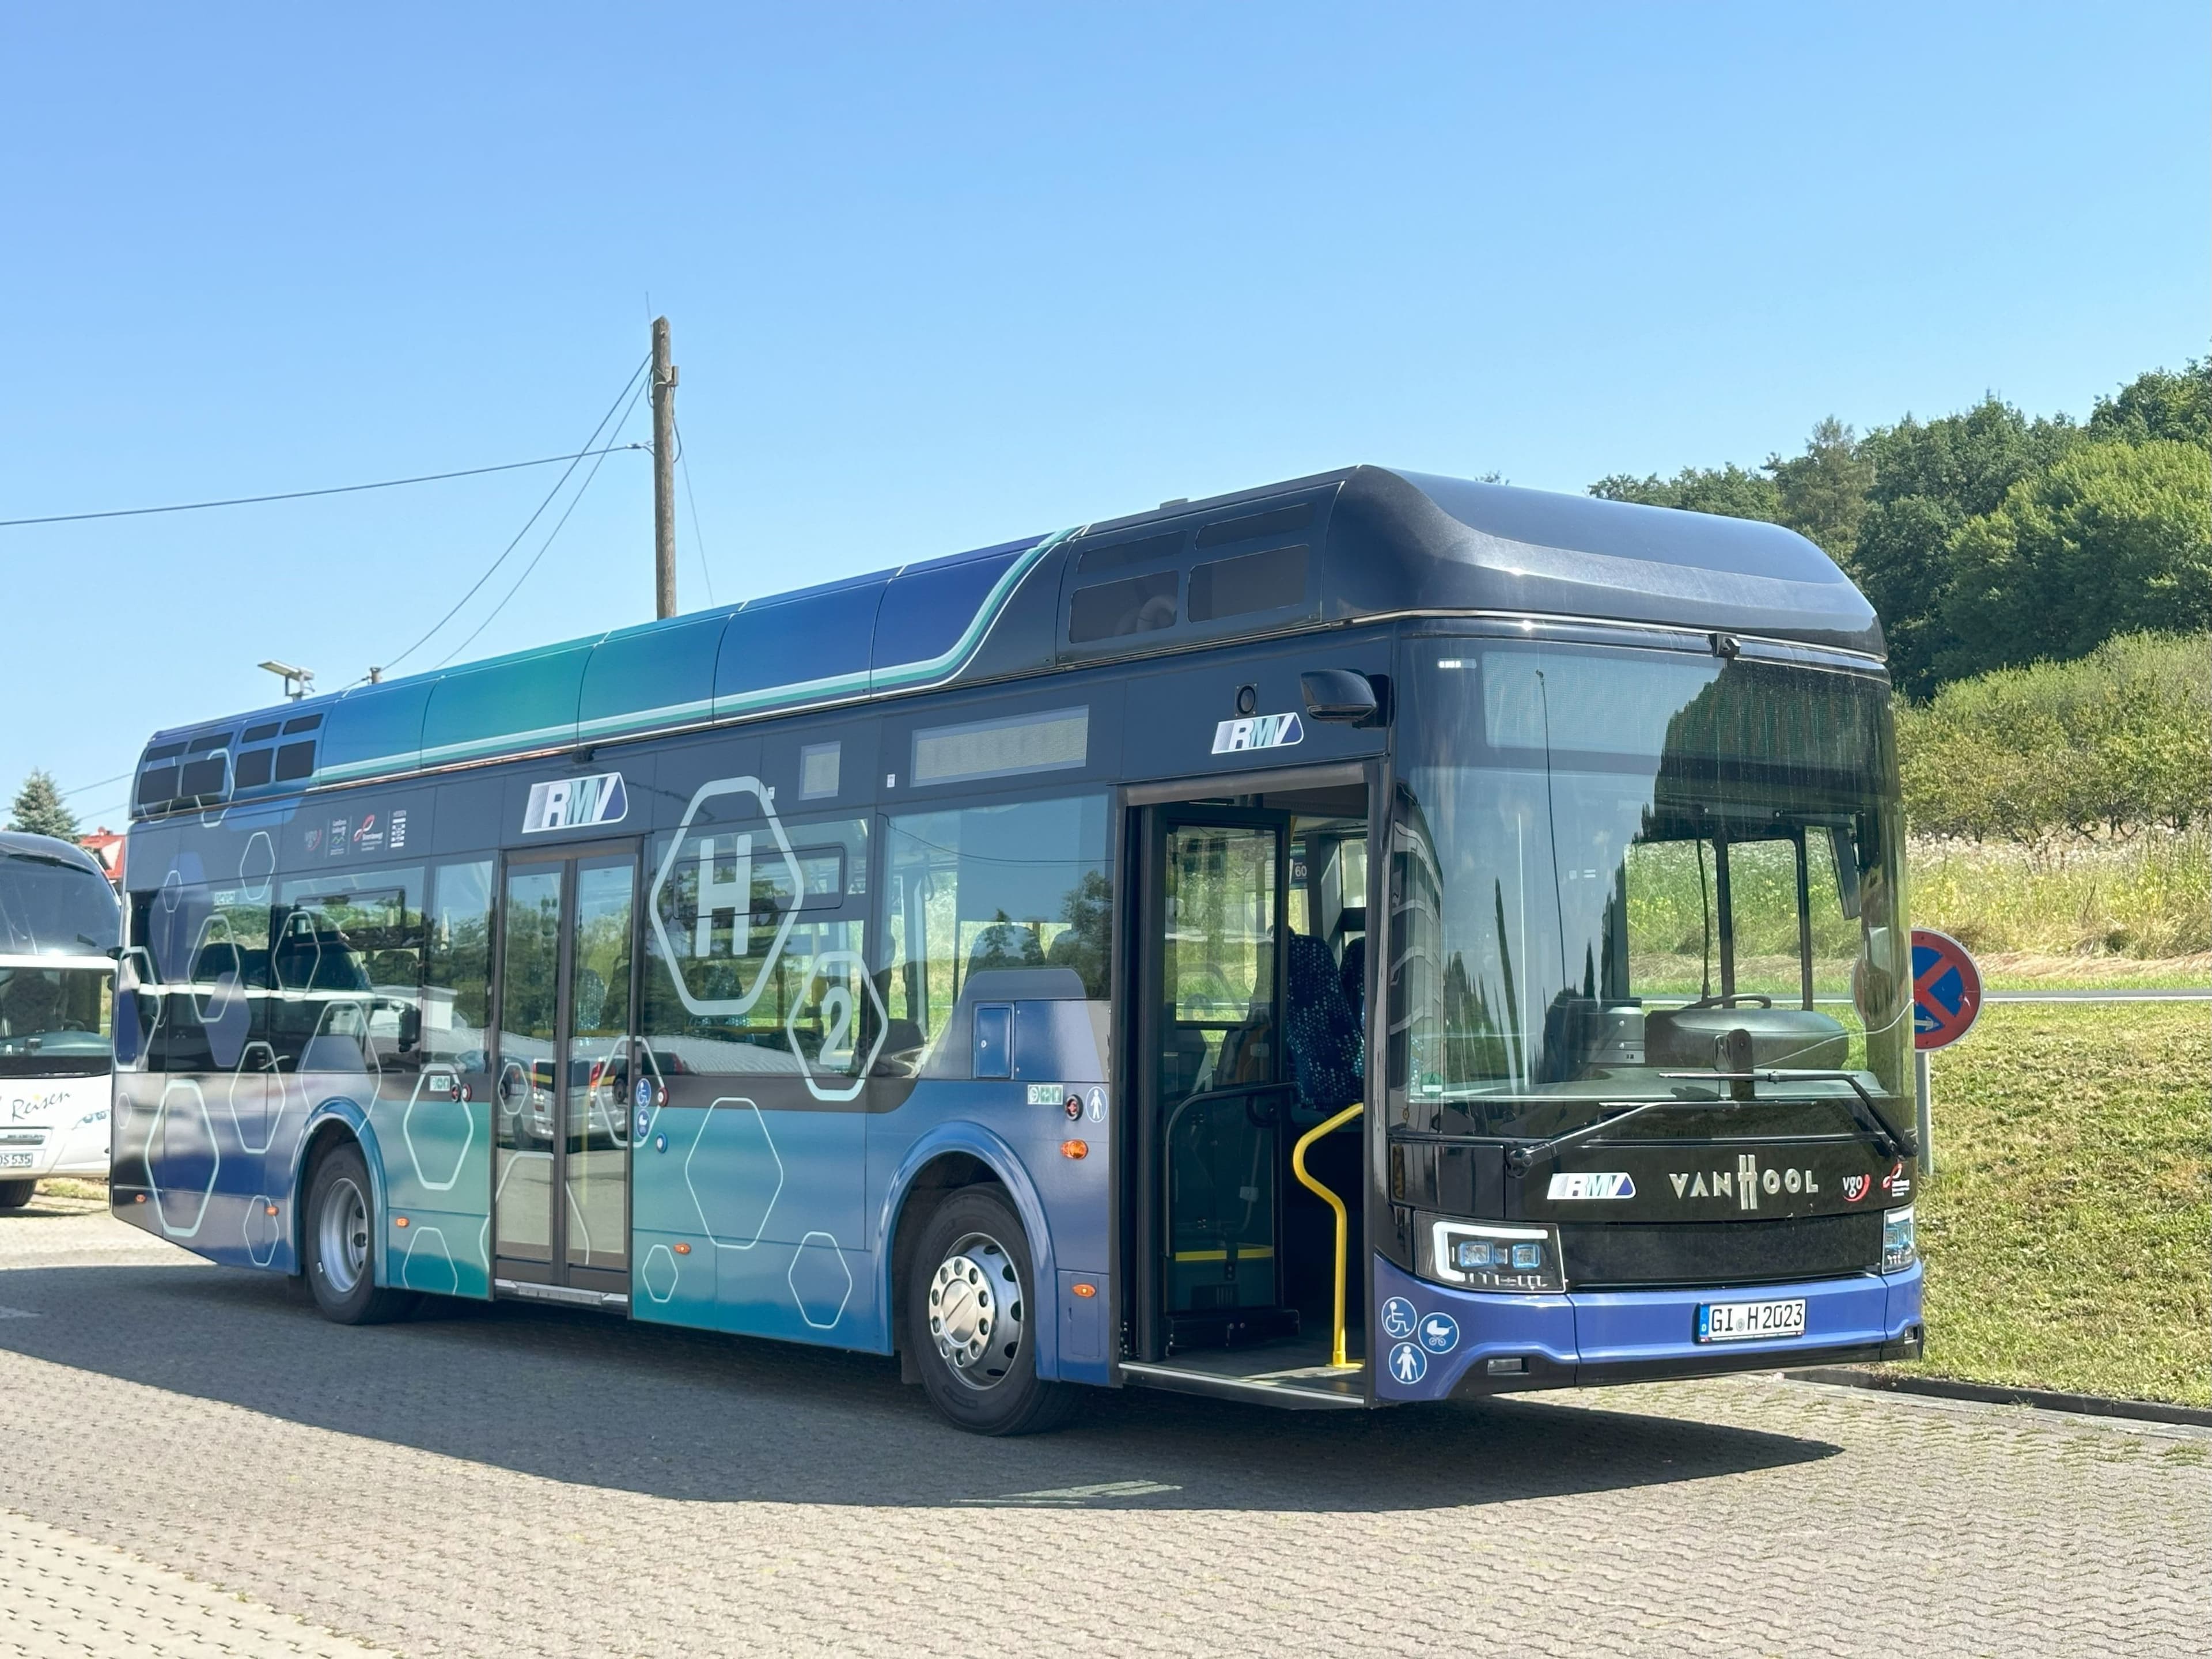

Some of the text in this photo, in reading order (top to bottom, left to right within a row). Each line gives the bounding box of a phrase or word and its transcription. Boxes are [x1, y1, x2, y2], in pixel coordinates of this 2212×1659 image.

[1227, 713, 1296, 750] RMV
[540, 775, 619, 830] RMV
[1295, 865, 1307, 877] 60
[696, 834, 852, 1065] H 2
[12, 1092, 71, 1123] Reisen
[1563, 1174, 1628, 1198] RMV
[1711, 1308, 1733, 1332] GI
[1763, 1303, 1803, 1329] 2023
